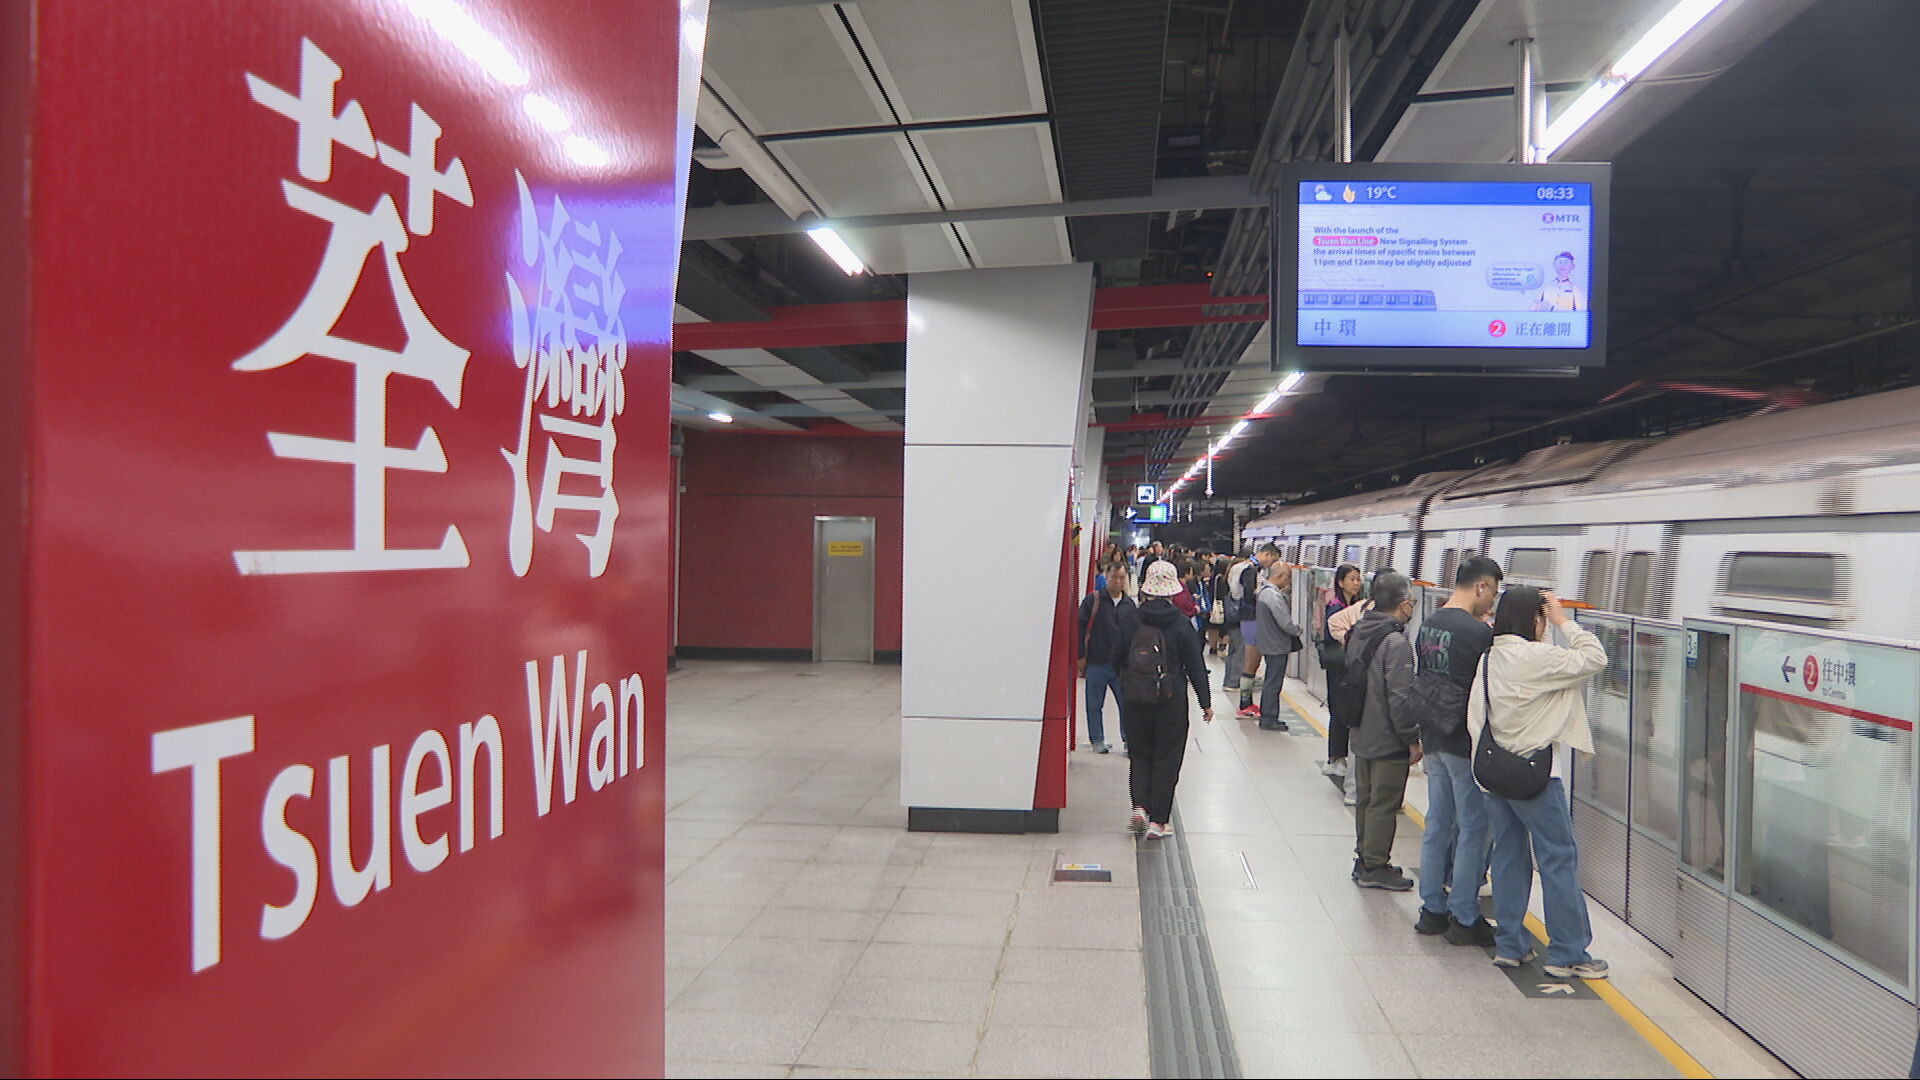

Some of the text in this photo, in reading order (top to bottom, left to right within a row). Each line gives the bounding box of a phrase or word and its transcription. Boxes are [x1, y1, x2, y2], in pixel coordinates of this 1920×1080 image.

[1366, 186, 1397, 199] 19°C
[1536, 187, 1574, 200] 08:33
[1555, 214, 1580, 223] MTR
[1313, 226, 1399, 234] With the launch of the
[1380, 237, 1397, 245] New
[1399, 237, 1438, 247] Signalling
[1440, 237, 1468, 247] System
[1388, 248, 1416, 257] specific
[1442, 248, 1476, 256] between
[1314, 259, 1336, 268] 11pm
[1377, 260, 1394, 268] may
[1407, 259, 1435, 268] slightly
[1437, 259, 1472, 268] adjusted
[232, 36, 627, 579] 荃灣
[1516, 321, 1571, 337] 正在離開
[1822, 657, 1856, 687] 往中環
[152, 649, 646, 974] Tsuen Wan
